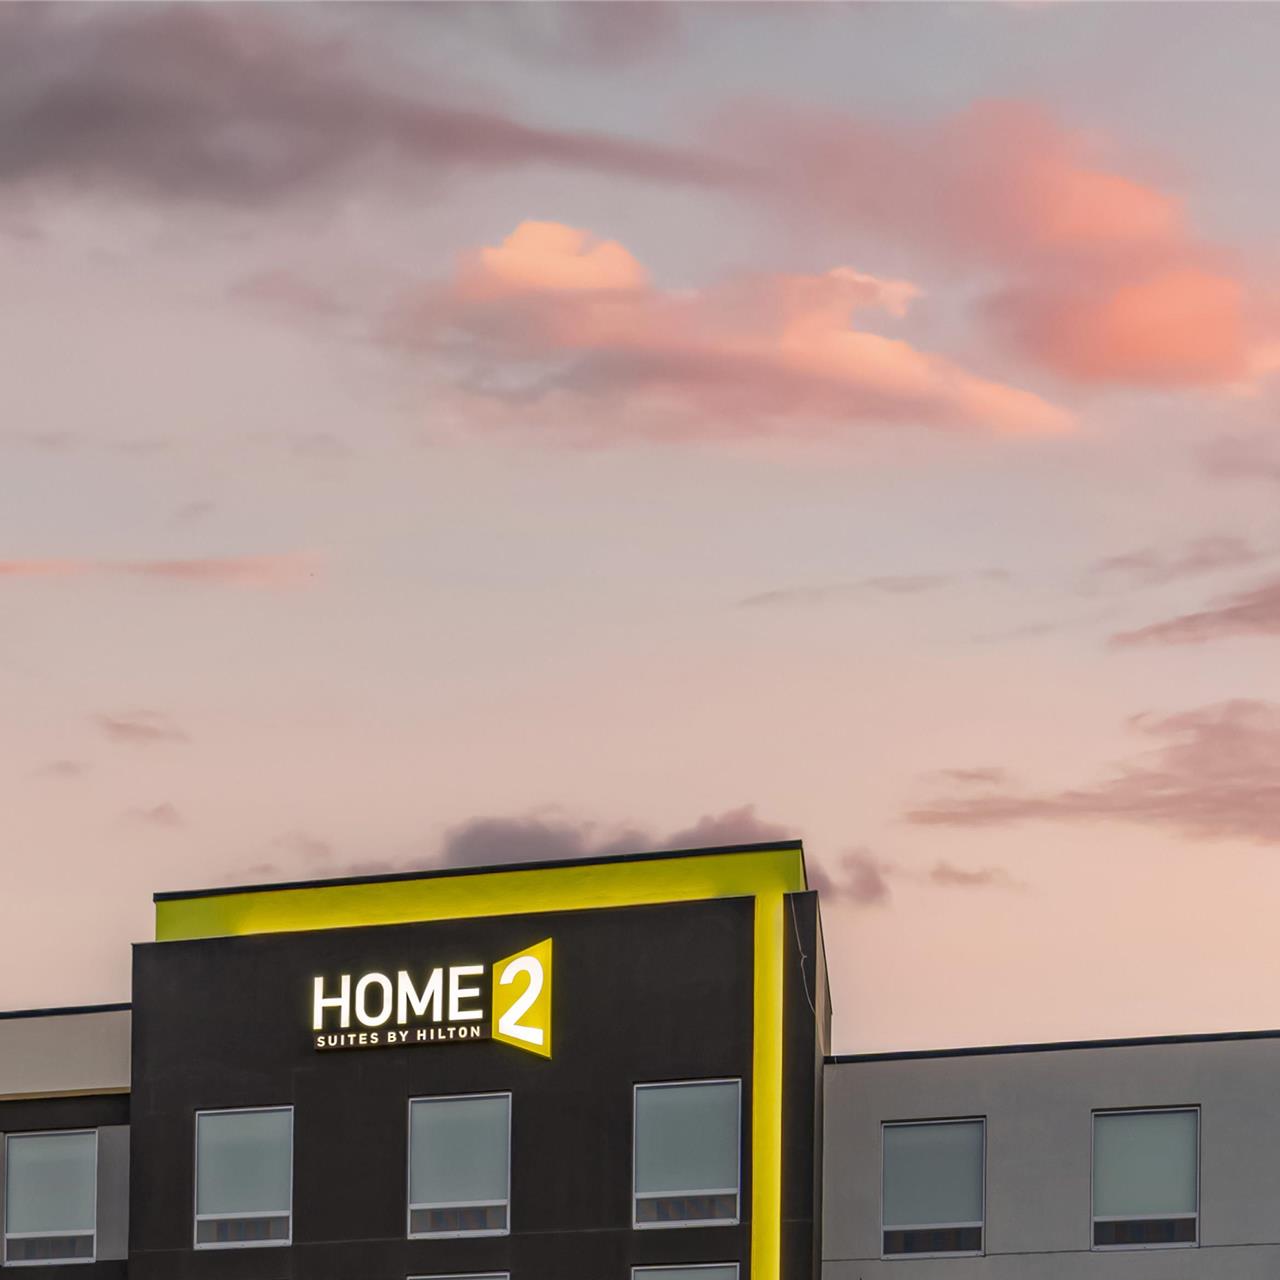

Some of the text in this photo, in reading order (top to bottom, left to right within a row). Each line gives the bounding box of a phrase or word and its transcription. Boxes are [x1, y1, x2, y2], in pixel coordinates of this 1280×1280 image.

[313, 955, 544, 1046] HOME 2
[317, 1025, 480, 1047] SUITES BY HILTON
